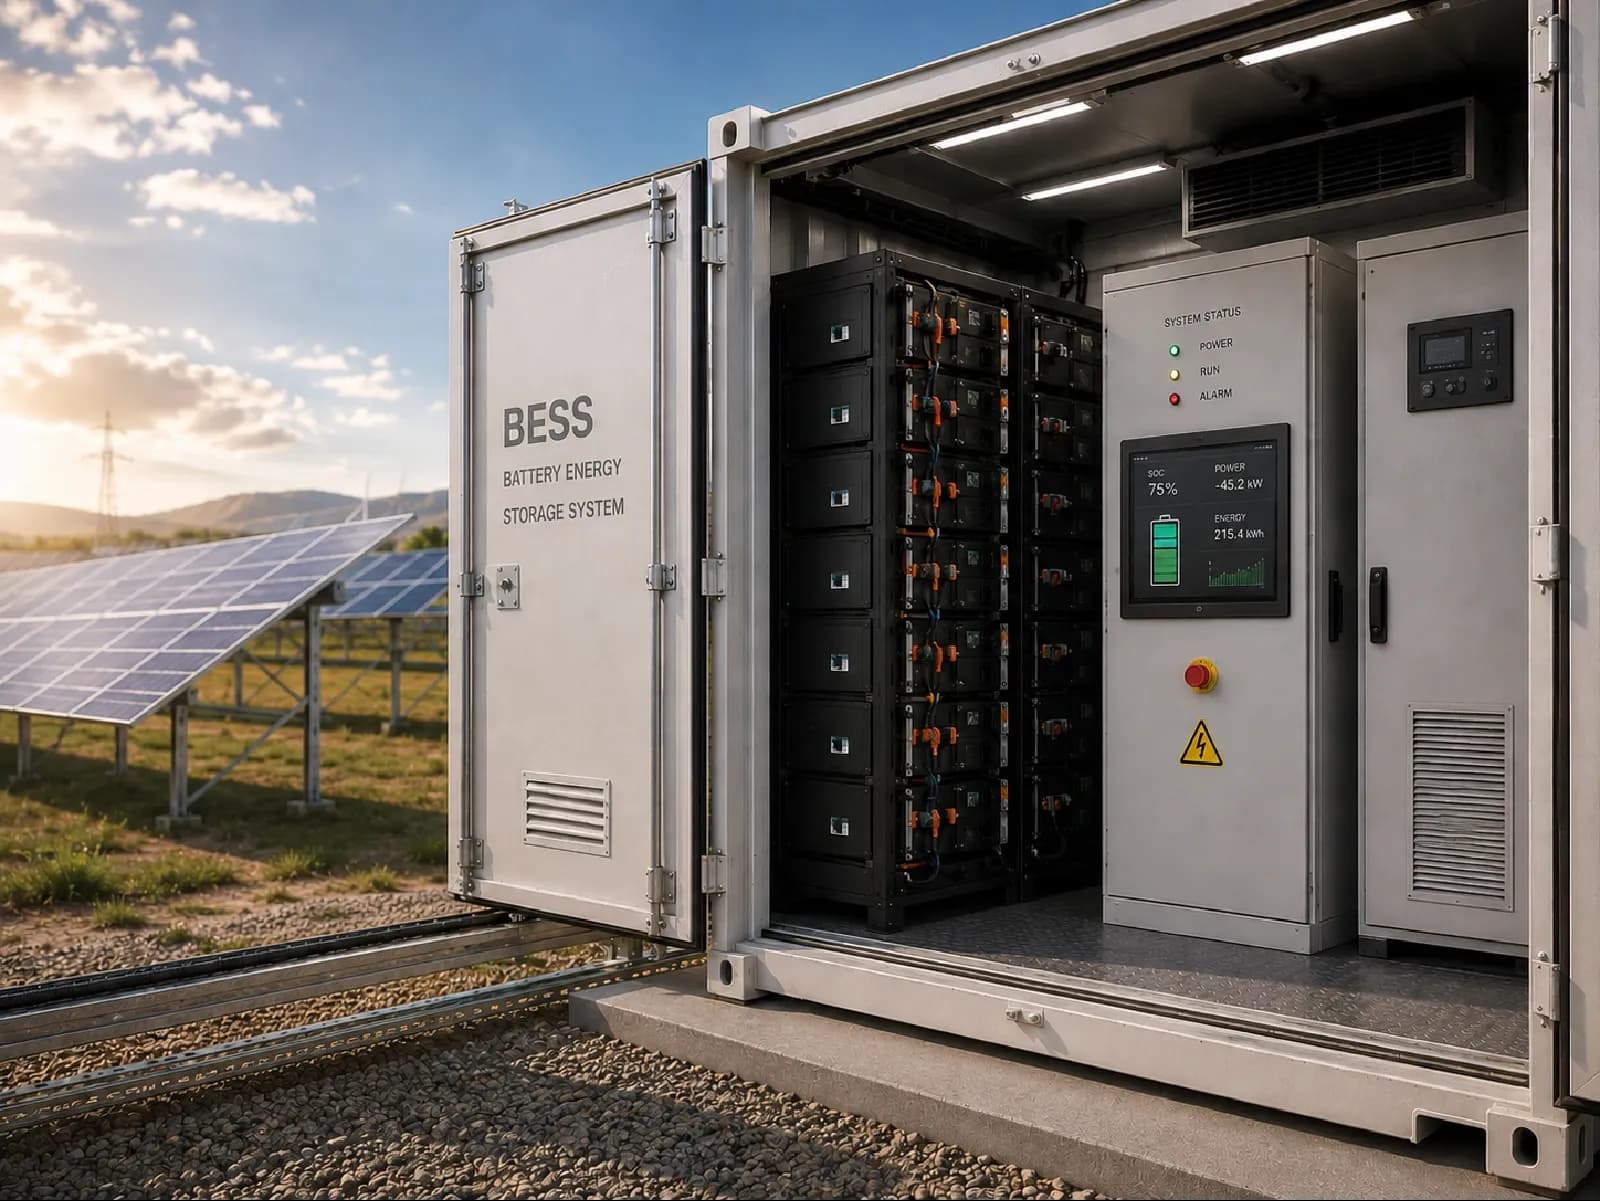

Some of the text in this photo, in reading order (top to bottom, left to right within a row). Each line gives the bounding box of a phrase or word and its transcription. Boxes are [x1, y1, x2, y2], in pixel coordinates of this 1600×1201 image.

[1164, 306, 1241, 328] SYSTEM STATUS
[1199, 338, 1233, 351] POWER
[1200, 365, 1220, 377] RUN
[1199, 388, 1233, 401] ALARM
[504, 395, 593, 448] BESS
[503, 458, 622, 487] BATTERY ENERGY
[1214, 462, 1246, 473] POWER
[1148, 482, 1178, 496] 75%
[1247, 478, 1264, 489] kW
[503, 497, 624, 525] STORAGE SYSTEM
[1214, 513, 1247, 523] ENERGY
[1214, 528, 1244, 541] 215.4
